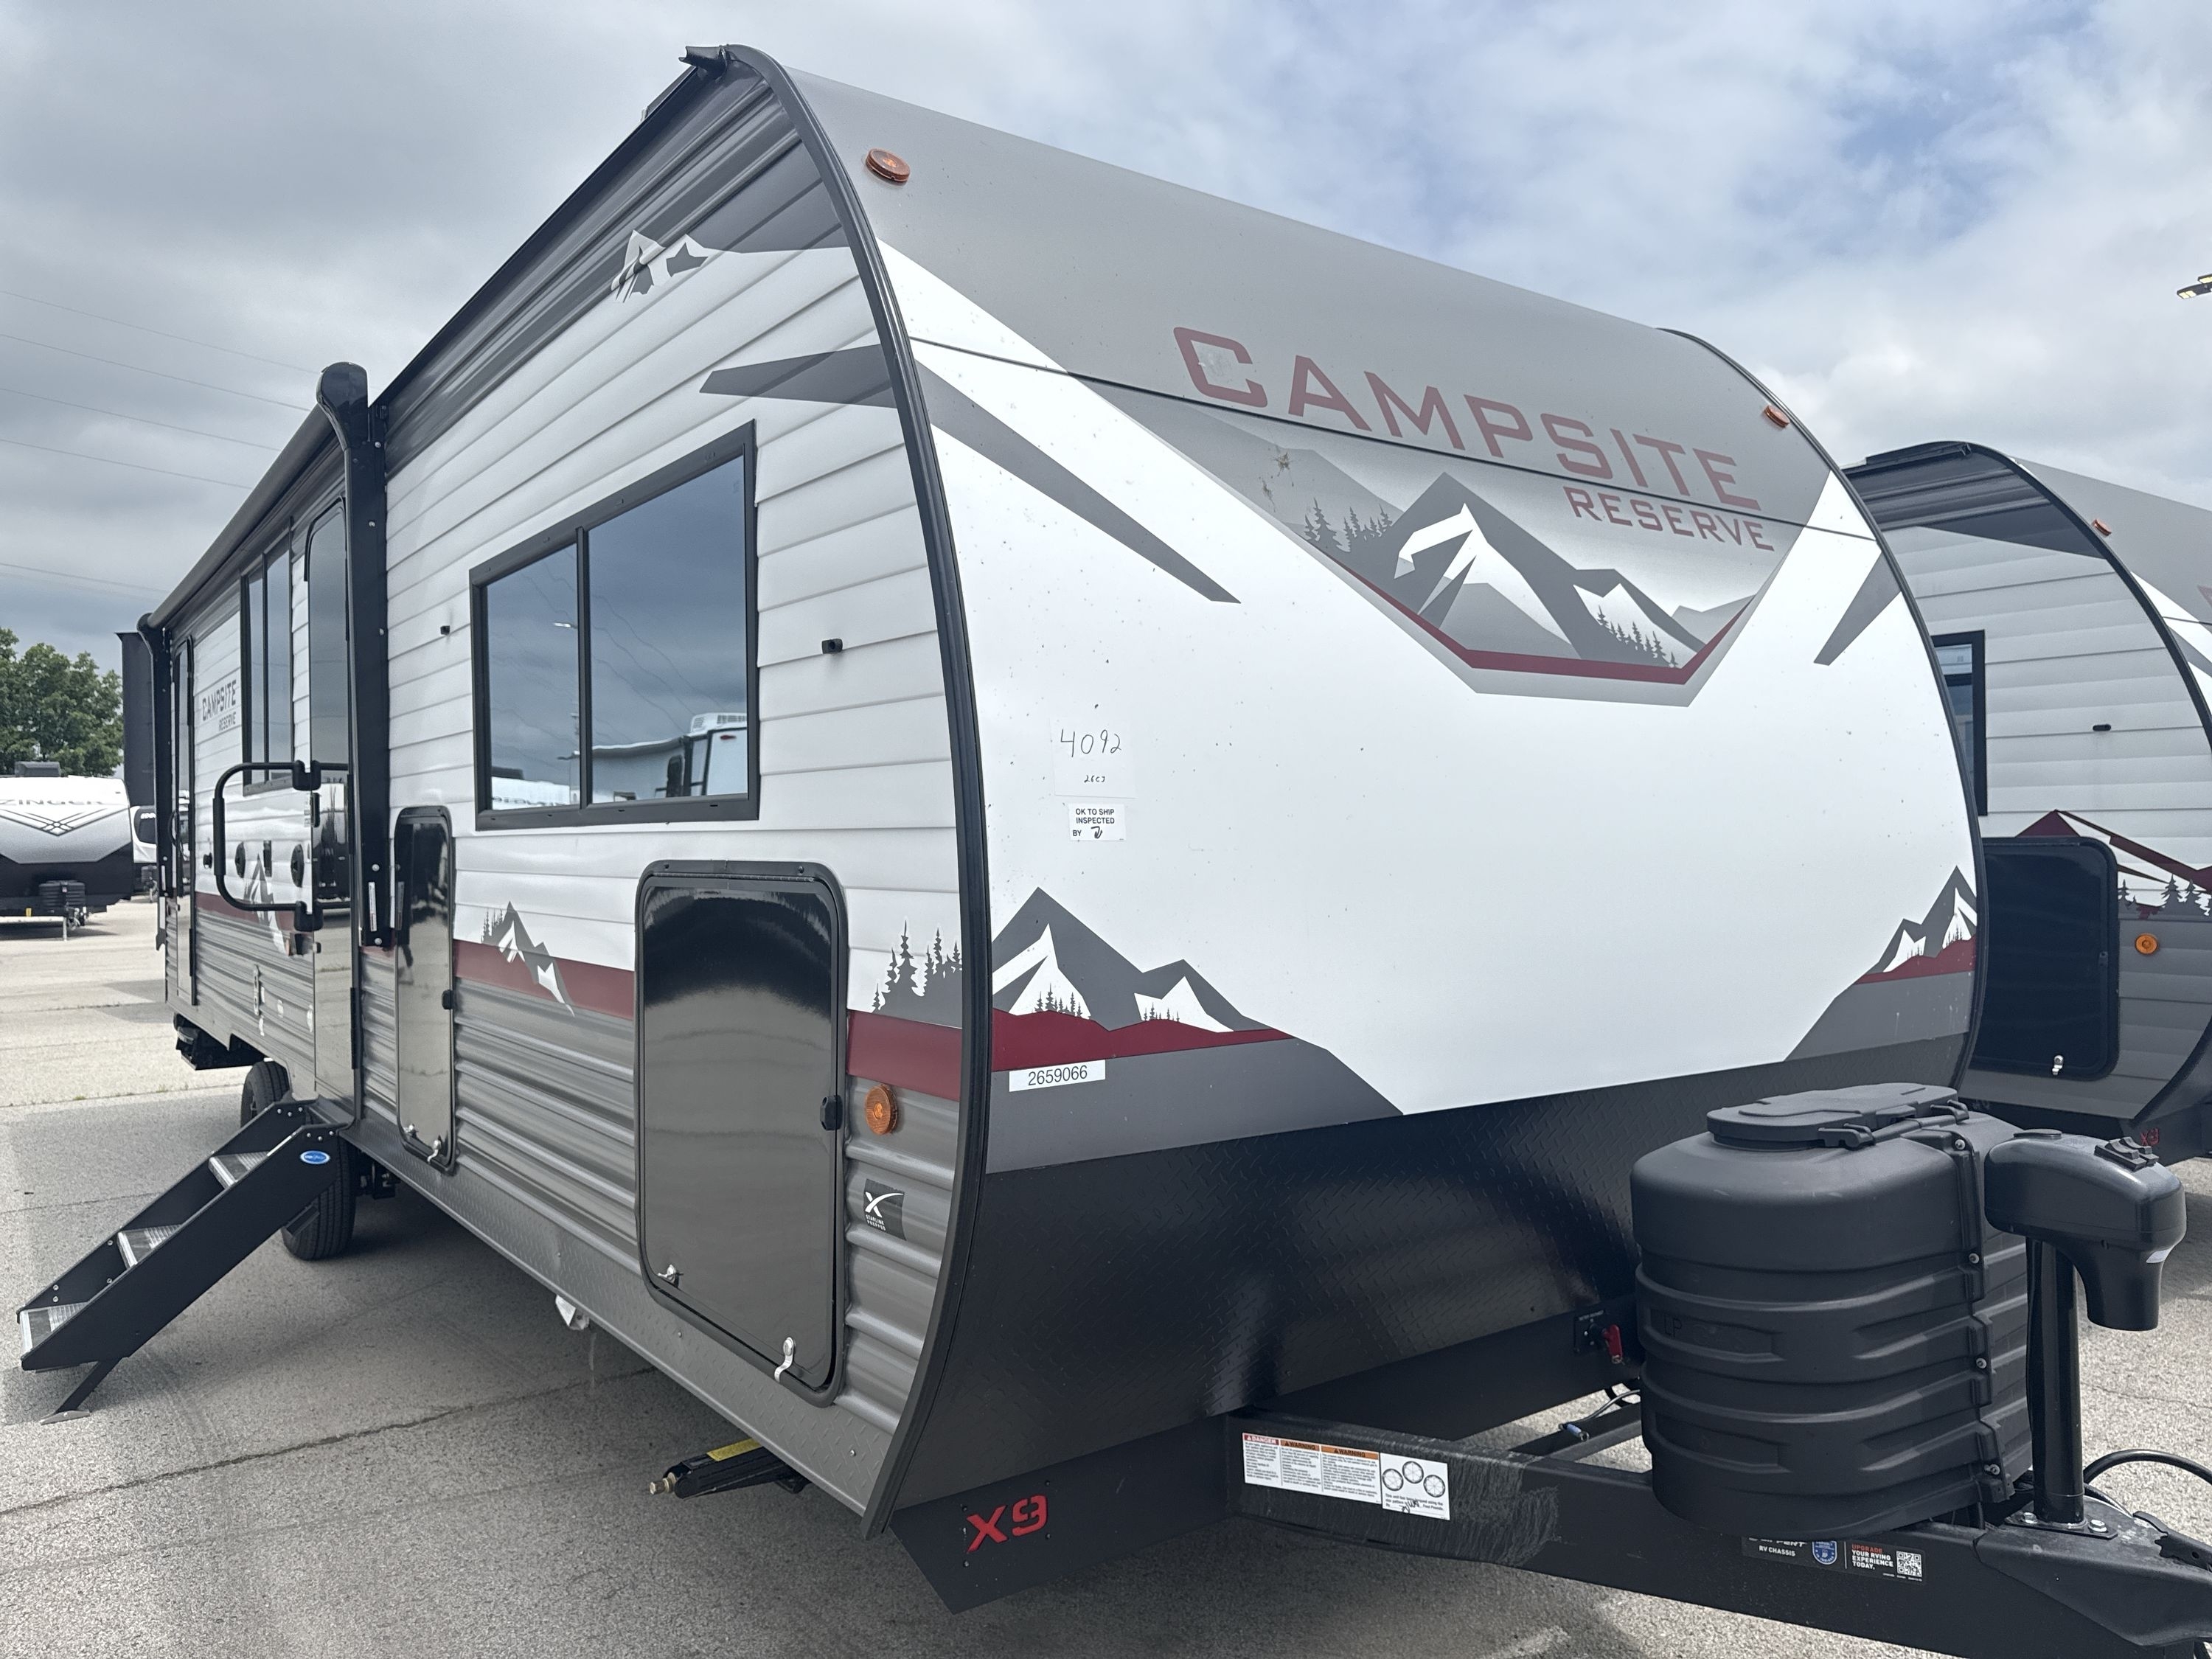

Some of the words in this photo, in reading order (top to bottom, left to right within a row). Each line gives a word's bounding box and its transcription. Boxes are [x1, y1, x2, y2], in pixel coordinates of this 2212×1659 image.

[1173, 327, 1761, 511] CAMPSITE
[1563, 485, 1775, 552] RESERVE
[202, 679, 237, 721] CAMPSITE
[1060, 728, 1121, 757] 4092
[1028, 1065, 1088, 1086] 2659066
[1251, 1436, 1276, 1444] DANGER
[966, 1494, 1048, 1554] X9
[1769, 1546, 1796, 1557] CHASSIS
[1851, 1543, 1882, 1554] UPGRADE
[1851, 1549, 1870, 1557] YOUR
[1871, 1552, 1891, 1561] RVING
[1852, 1555, 1893, 1568] EXPERIENCE
[1852, 1561, 1876, 1570] TODAY.
